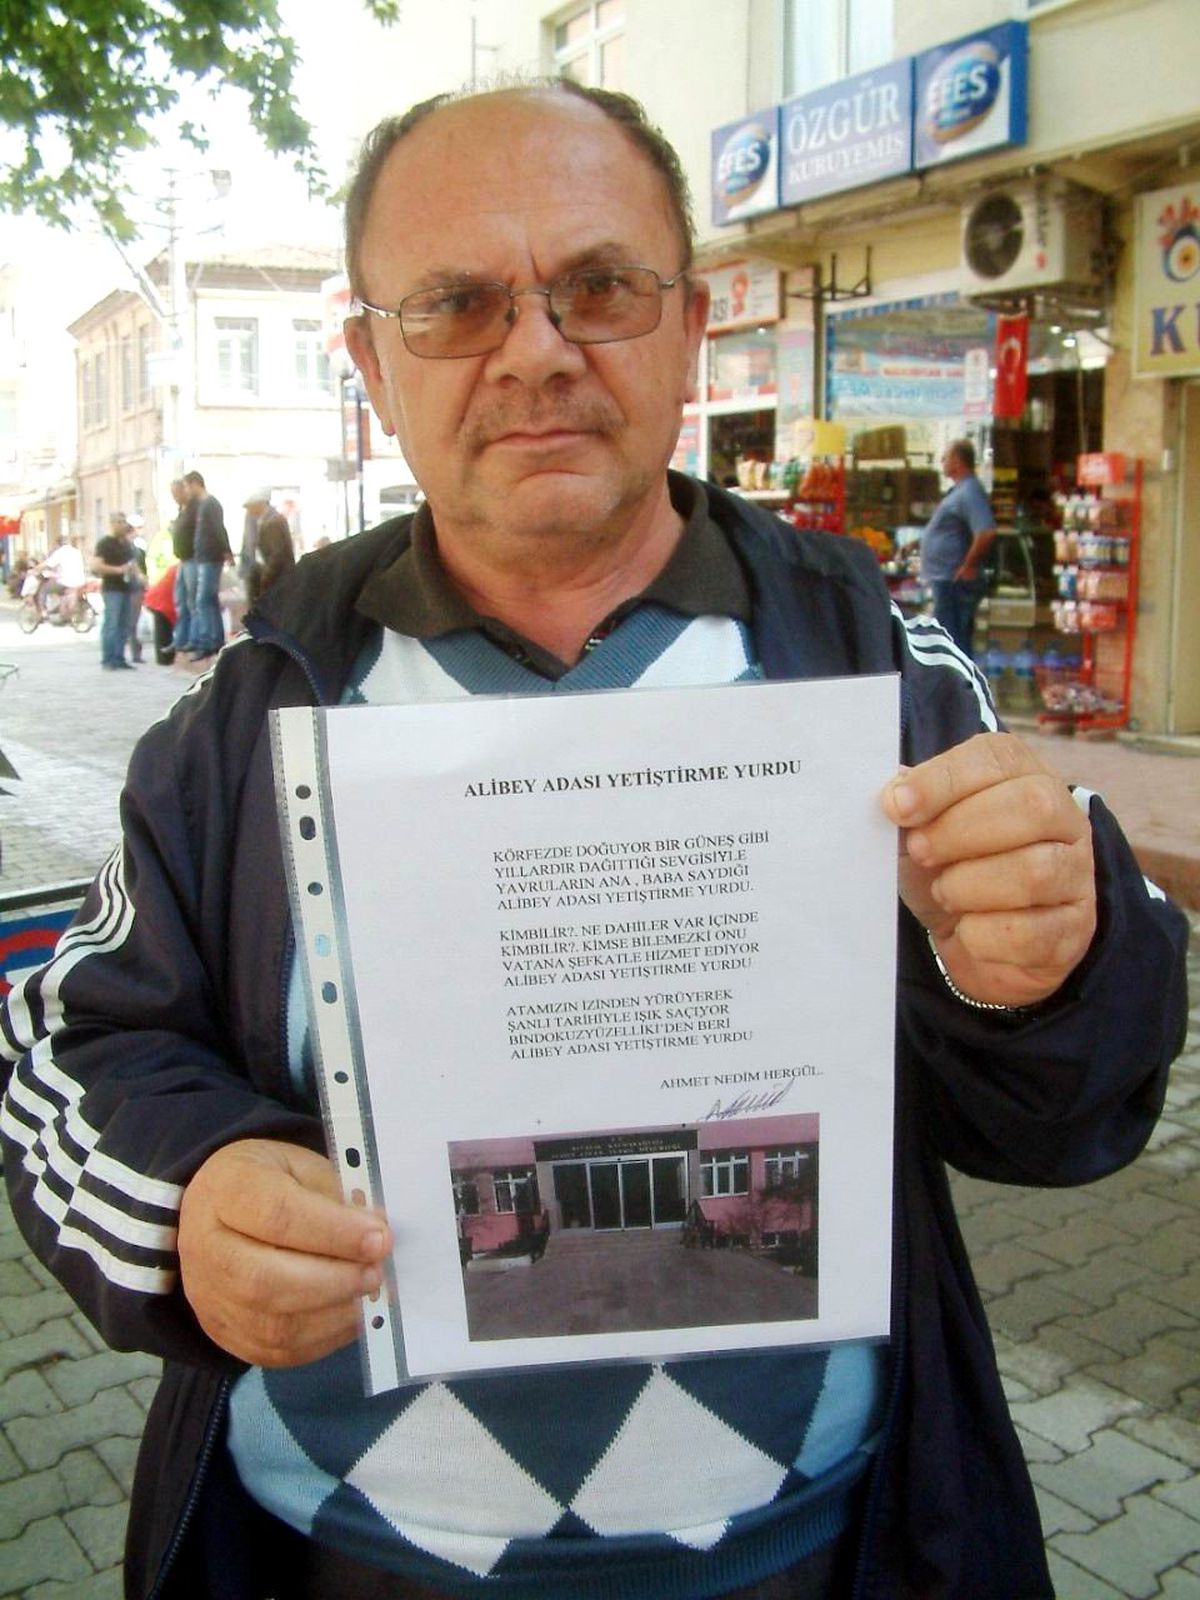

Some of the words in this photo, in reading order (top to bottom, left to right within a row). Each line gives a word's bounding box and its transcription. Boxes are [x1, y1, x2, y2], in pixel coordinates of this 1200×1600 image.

[787, 78, 902, 155] ÖZGÜR
[464, 778, 537, 798] ALİBEY
[543, 773, 601, 793] ADASI
[607, 765, 728, 789] YETİŞTİRME
[734, 760, 802, 779] YURDU
[493, 846, 573, 863] KÖRFEZDE
[577, 841, 652, 857] DOĞUYOR
[655, 838, 680, 852] BİR
[684, 834, 735, 850] GÜNEŞ
[738, 830, 769, 845] GİBİ
[494, 862, 576, 879] YILLARDIR
[580, 857, 656, 873] DAĞITTIĞI
[659, 849, 747, 868] SEVGİSİYLE
[496, 878, 595, 895] YAVRULARIN
[599, 875, 631, 888] ANA
[642, 872, 684, 885] BABA
[688, 865, 749, 882] SAYDIĞI
[497, 896, 552, 911] ALİBEY
[556, 893, 601, 907] ADASI
[605, 886, 694, 904] YETİŞTİRME
[582, 925, 602, 937] NE
[605, 919, 669, 935] DAHİLER
[674, 917, 705, 929] VAR
[708, 911, 759, 927] İÇİNDE
[582, 939, 628, 952] KİMSE
[715, 928, 747, 940] ONU
[502, 957, 565, 971] VATANA
[568, 952, 642, 969] ŞEFKATLE
[645, 946, 701, 962] HİZMET
[504, 973, 558, 987] ALİBEY
[561, 969, 605, 983] ADASI
[610, 962, 696, 979] YETİŞTİRME
[700, 957, 752, 972] YURDU
[506, 1001, 578, 1017] ATAMIZIN
[645, 989, 733, 1006] YÜRÜYEREK
[507, 1018, 551, 1033] ŞANLI
[666, 1004, 730, 1019] SAÇIYOR
[698, 1017, 731, 1031] BERİ
[511, 1046, 563, 1060] ALİBEY
[567, 1042, 611, 1056] ADASI
[703, 1031, 753, 1045] YURDU
[660, 1075, 712, 1090] AHMET
[714, 1071, 760, 1085] NEDİM
